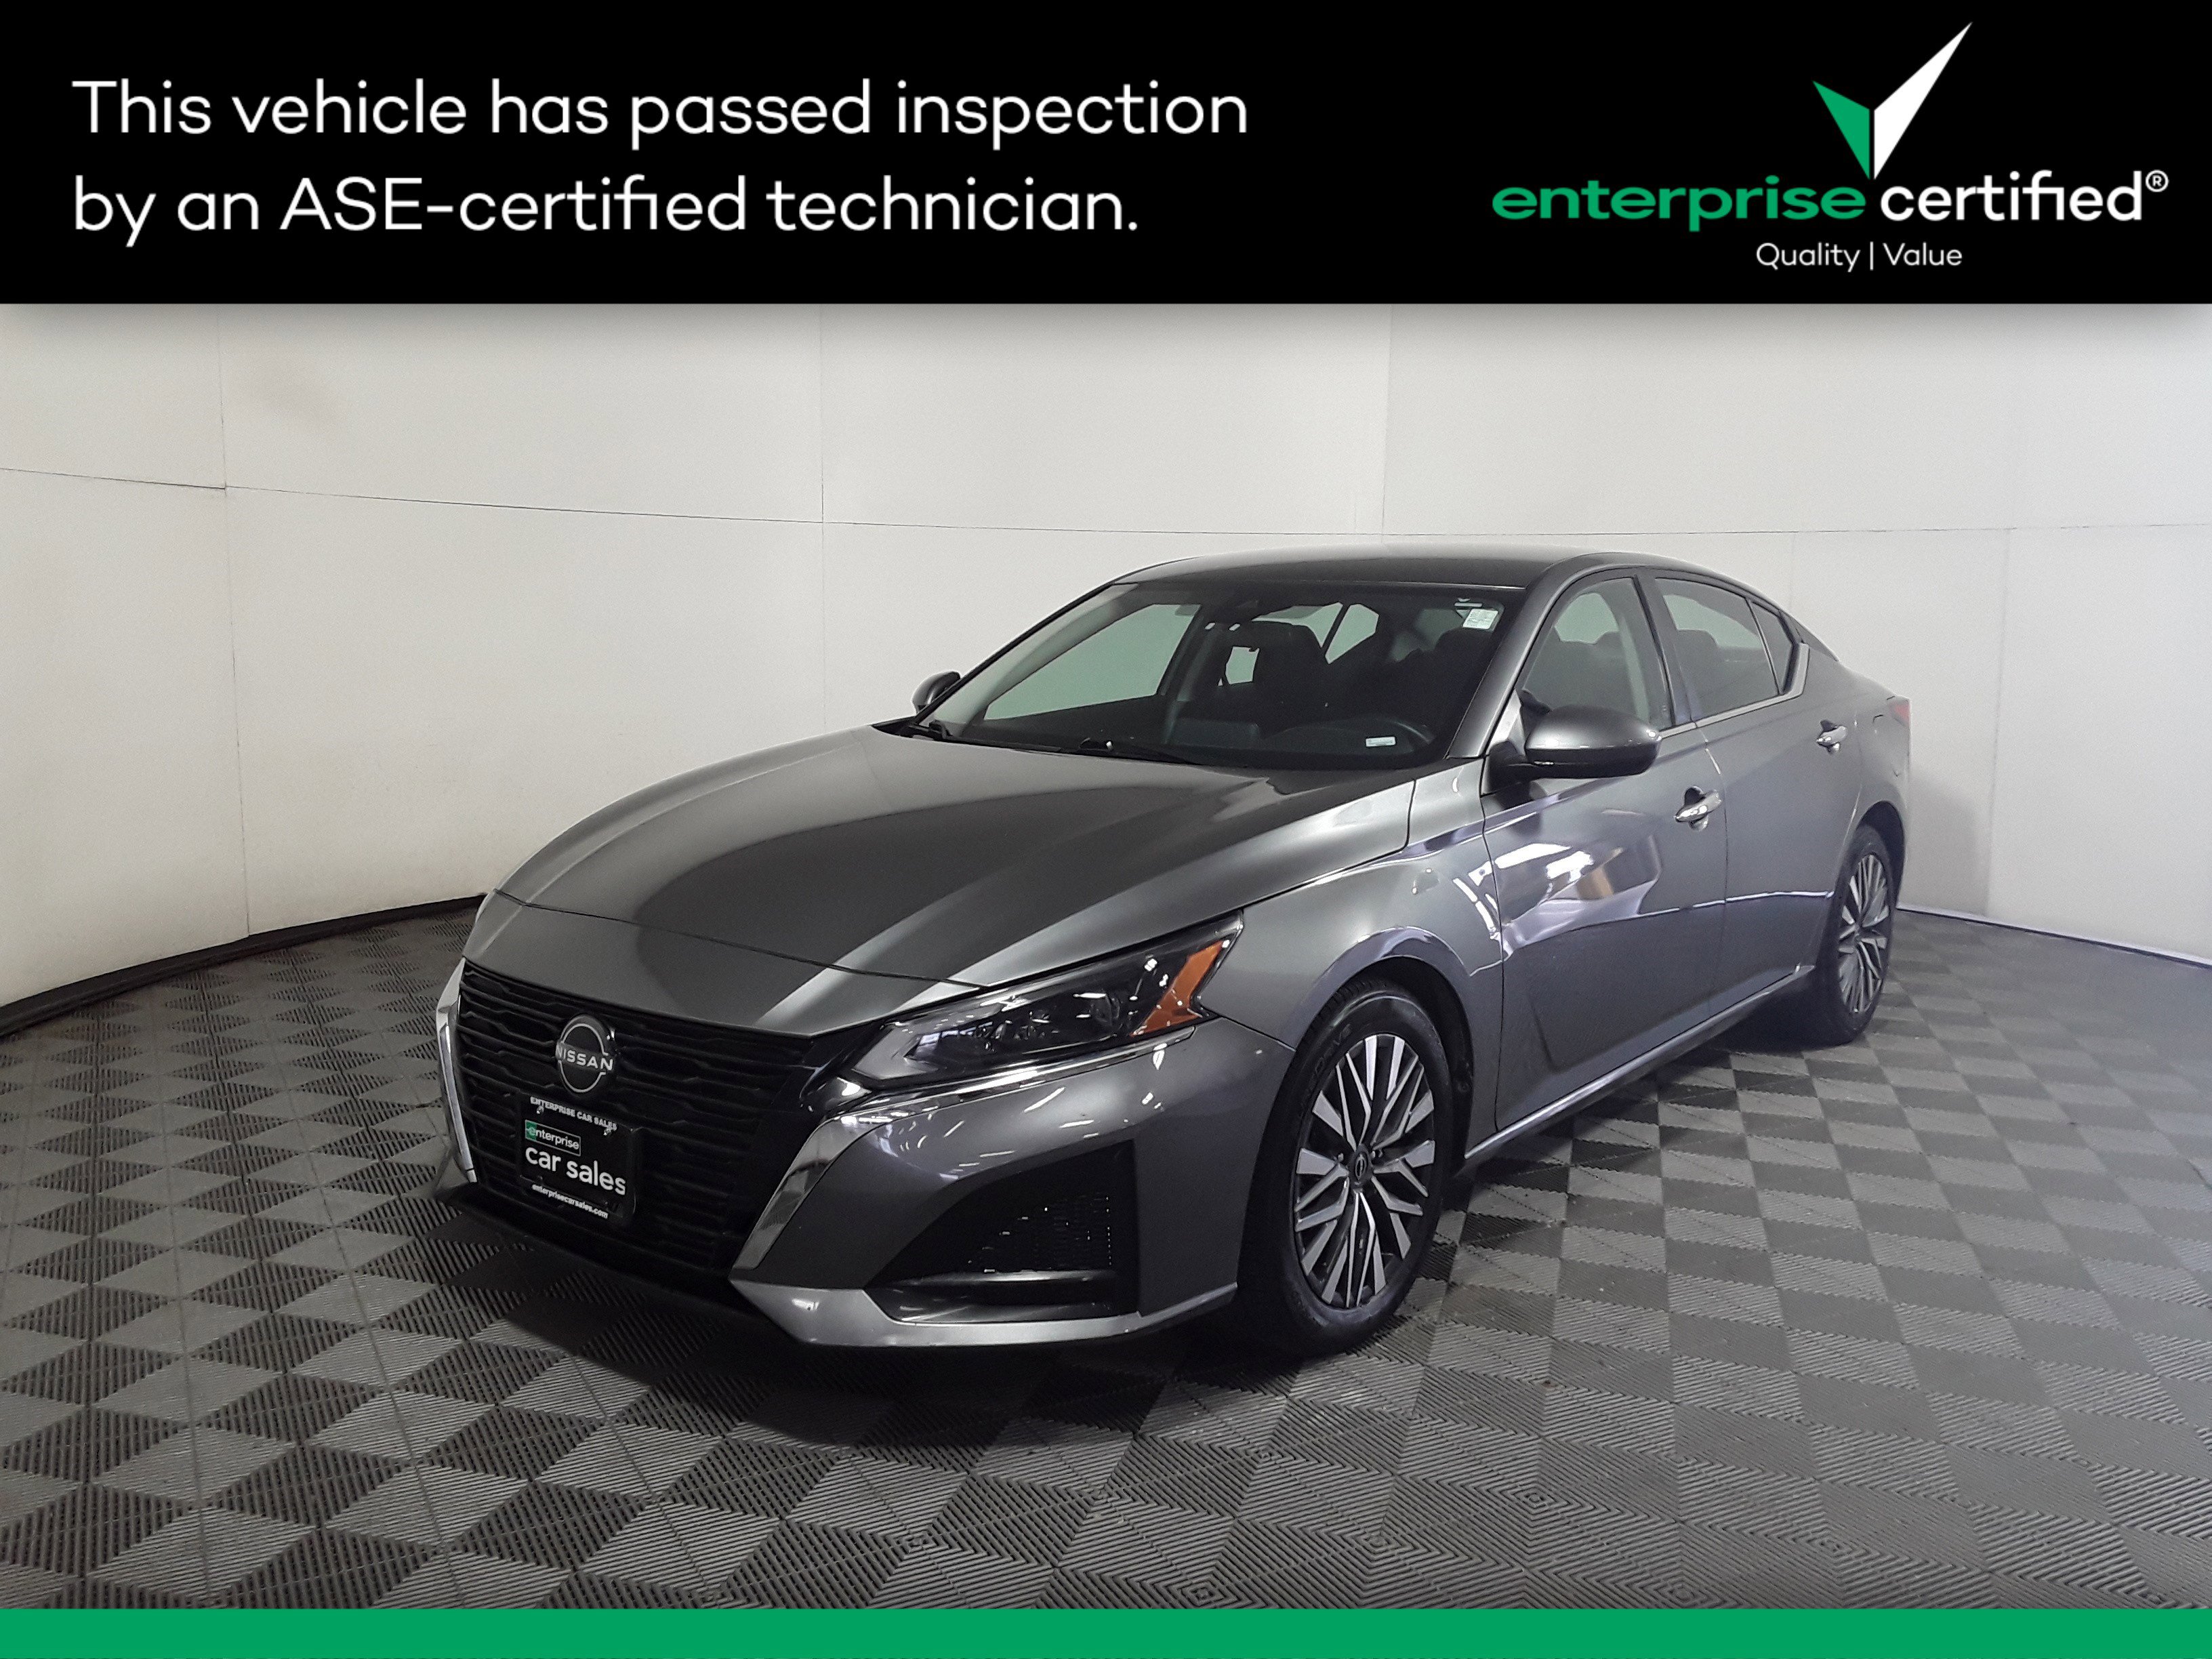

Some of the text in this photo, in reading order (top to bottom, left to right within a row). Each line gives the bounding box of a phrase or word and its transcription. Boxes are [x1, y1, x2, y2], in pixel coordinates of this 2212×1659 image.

[556, 1043, 613, 1071] NISSAN
[530, 1096, 618, 1132] ENTERPRISE CAR SALES
[527, 1126, 579, 1150] enterprise
[525, 1147, 626, 1196] car sales
[531, 1184, 609, 1219] enterprisecarsales.com
